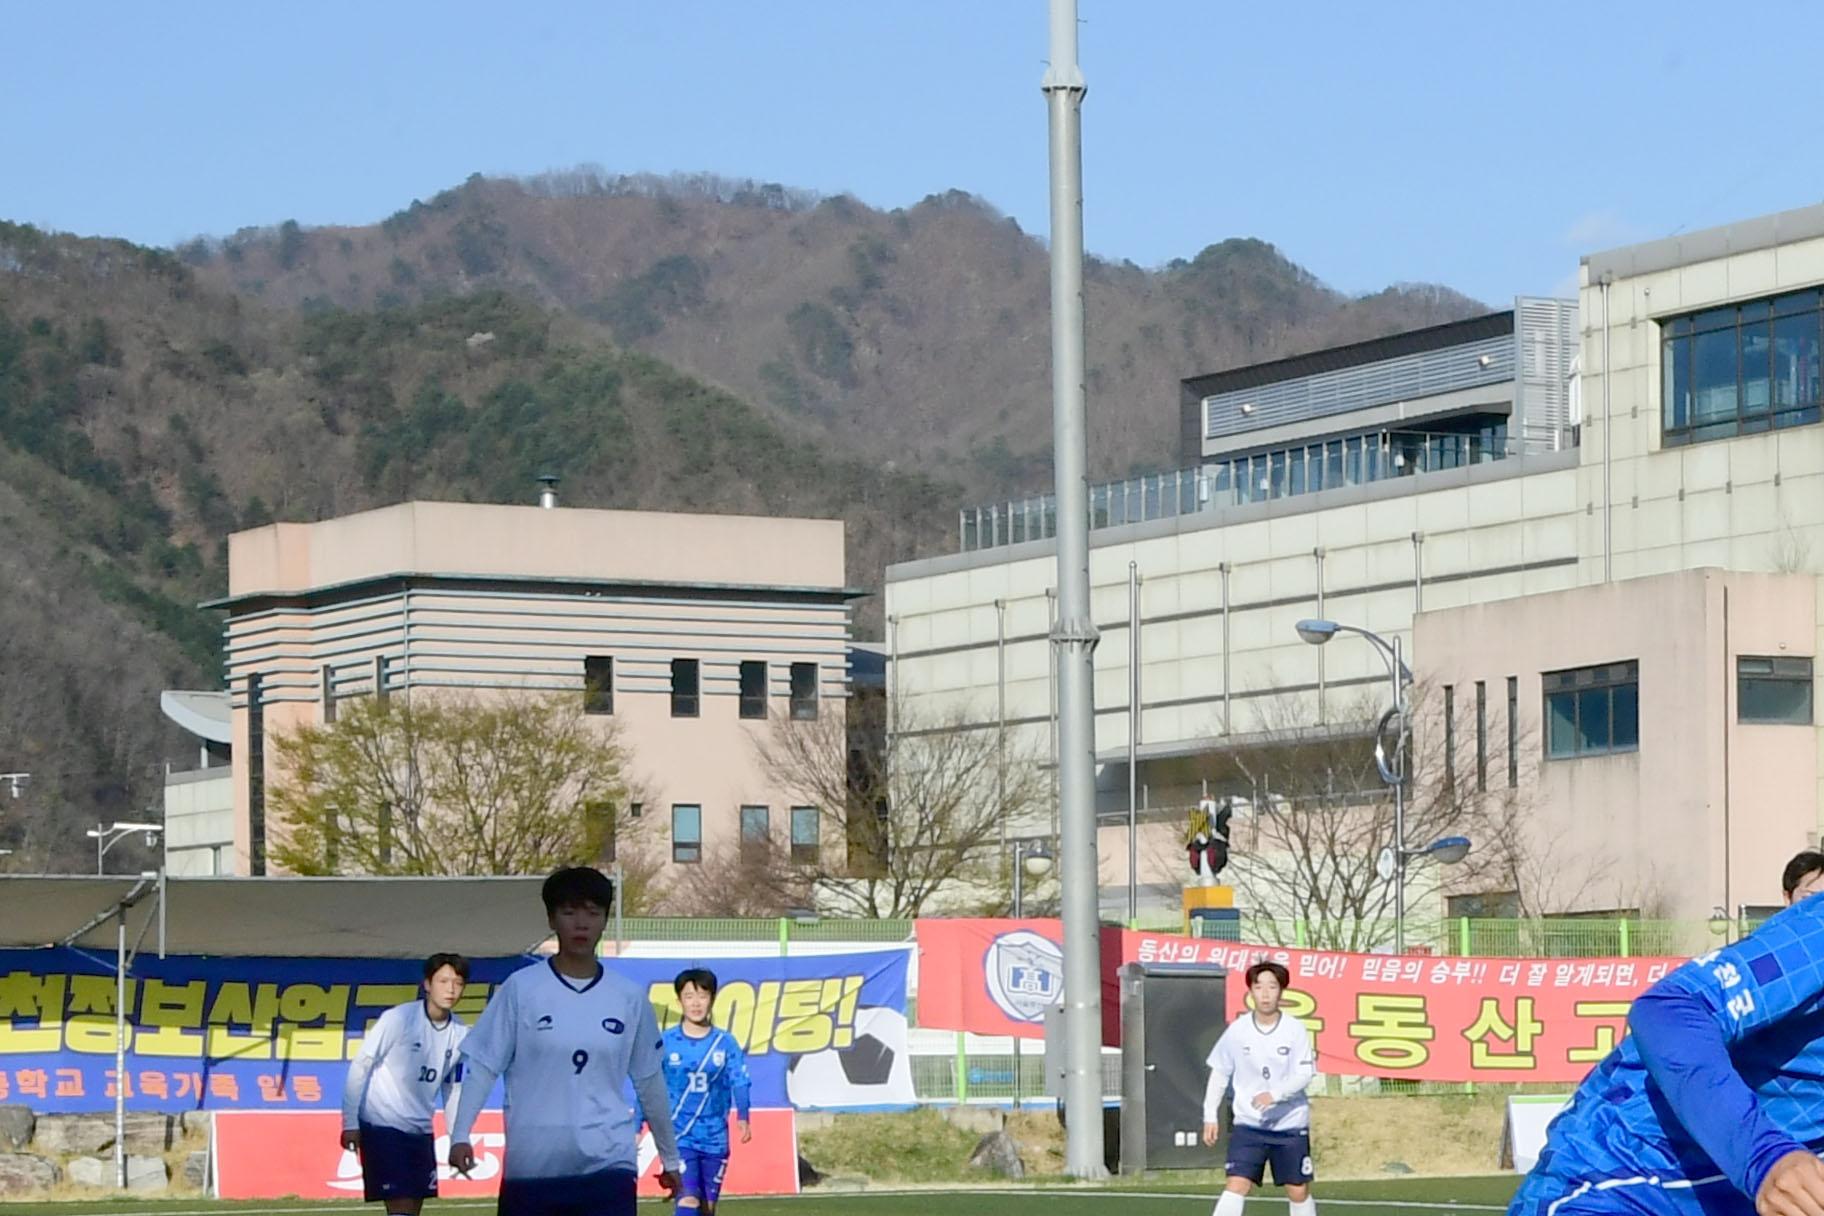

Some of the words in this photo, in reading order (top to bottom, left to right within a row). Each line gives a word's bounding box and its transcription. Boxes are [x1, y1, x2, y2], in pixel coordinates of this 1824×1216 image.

[1138, 938, 1200, 962] 동산의
[1301, 954, 1347, 979] 믿어!
[1362, 960, 1423, 983] 믿음의
[1430, 961, 1487, 984] 승부!!
[1501, 963, 1520, 985] 더
[1528, 963, 1547, 986] 잘
[1554, 963, 1638, 986] 알게되면,
[572, 1049, 588, 1075] 9
[1261, 1066, 1271, 1080] 8
[418, 1066, 437, 1082] 20
[688, 1071, 710, 1093] 13
